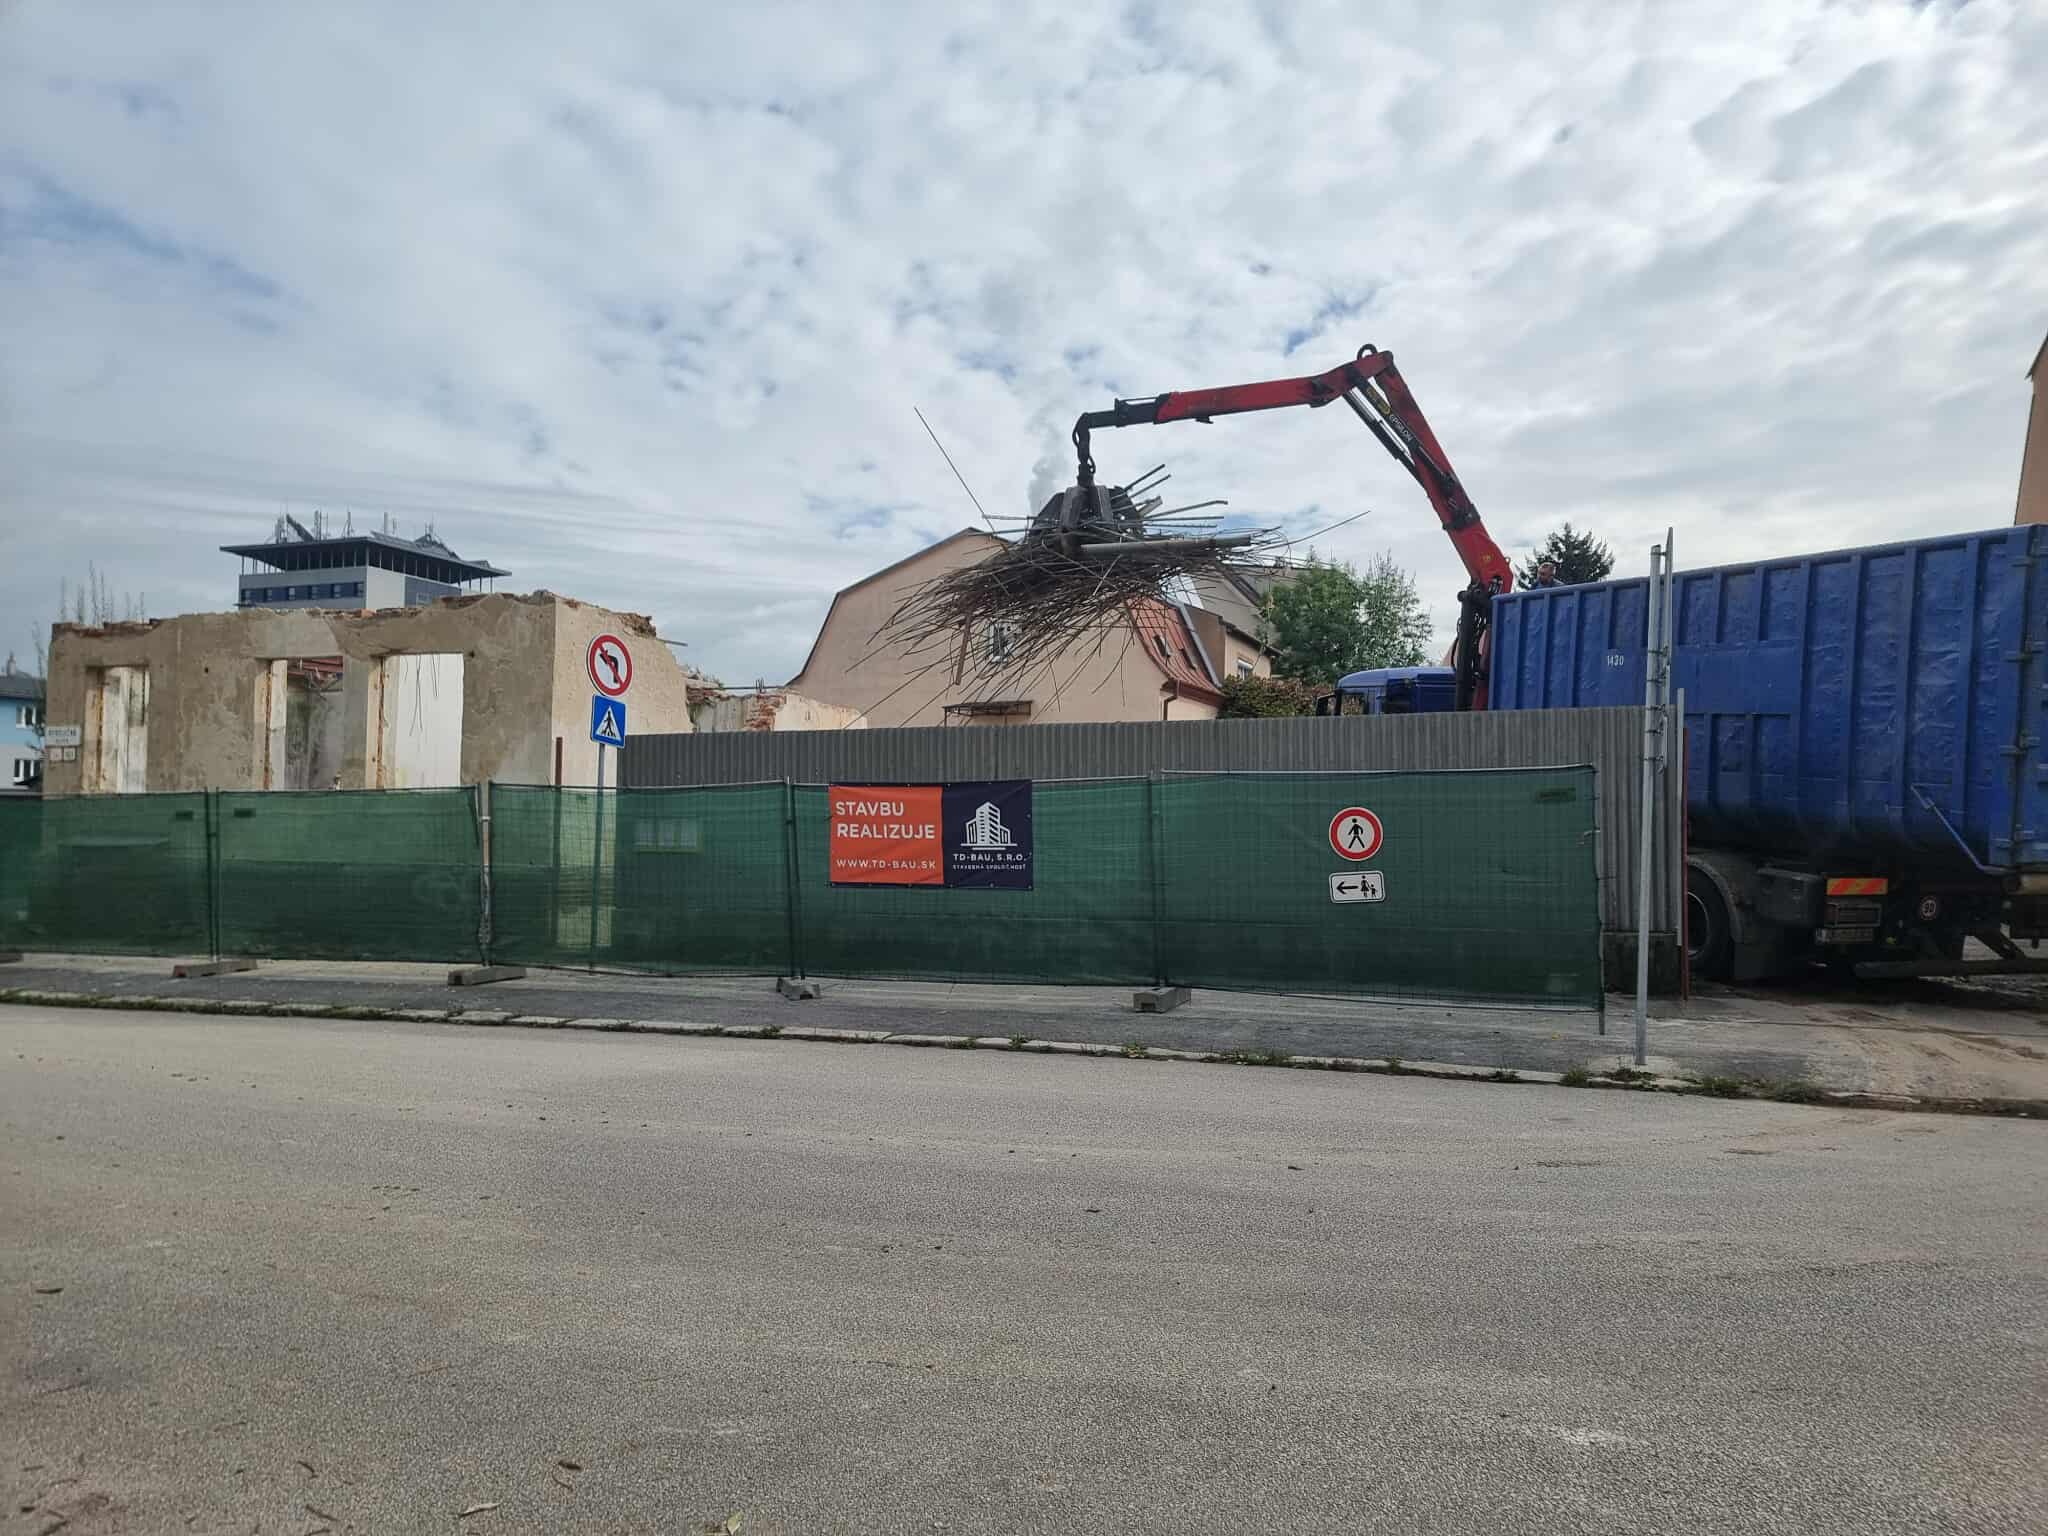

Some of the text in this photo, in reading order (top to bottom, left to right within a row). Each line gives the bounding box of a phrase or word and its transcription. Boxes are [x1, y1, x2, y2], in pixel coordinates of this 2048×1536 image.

[835, 801, 904, 817] STAVBU
[837, 823, 936, 840] REALIZUJE
[997, 853, 1026, 862] S.R.O.
[836, 859, 936, 870] WWW.TD-BAU.SK
